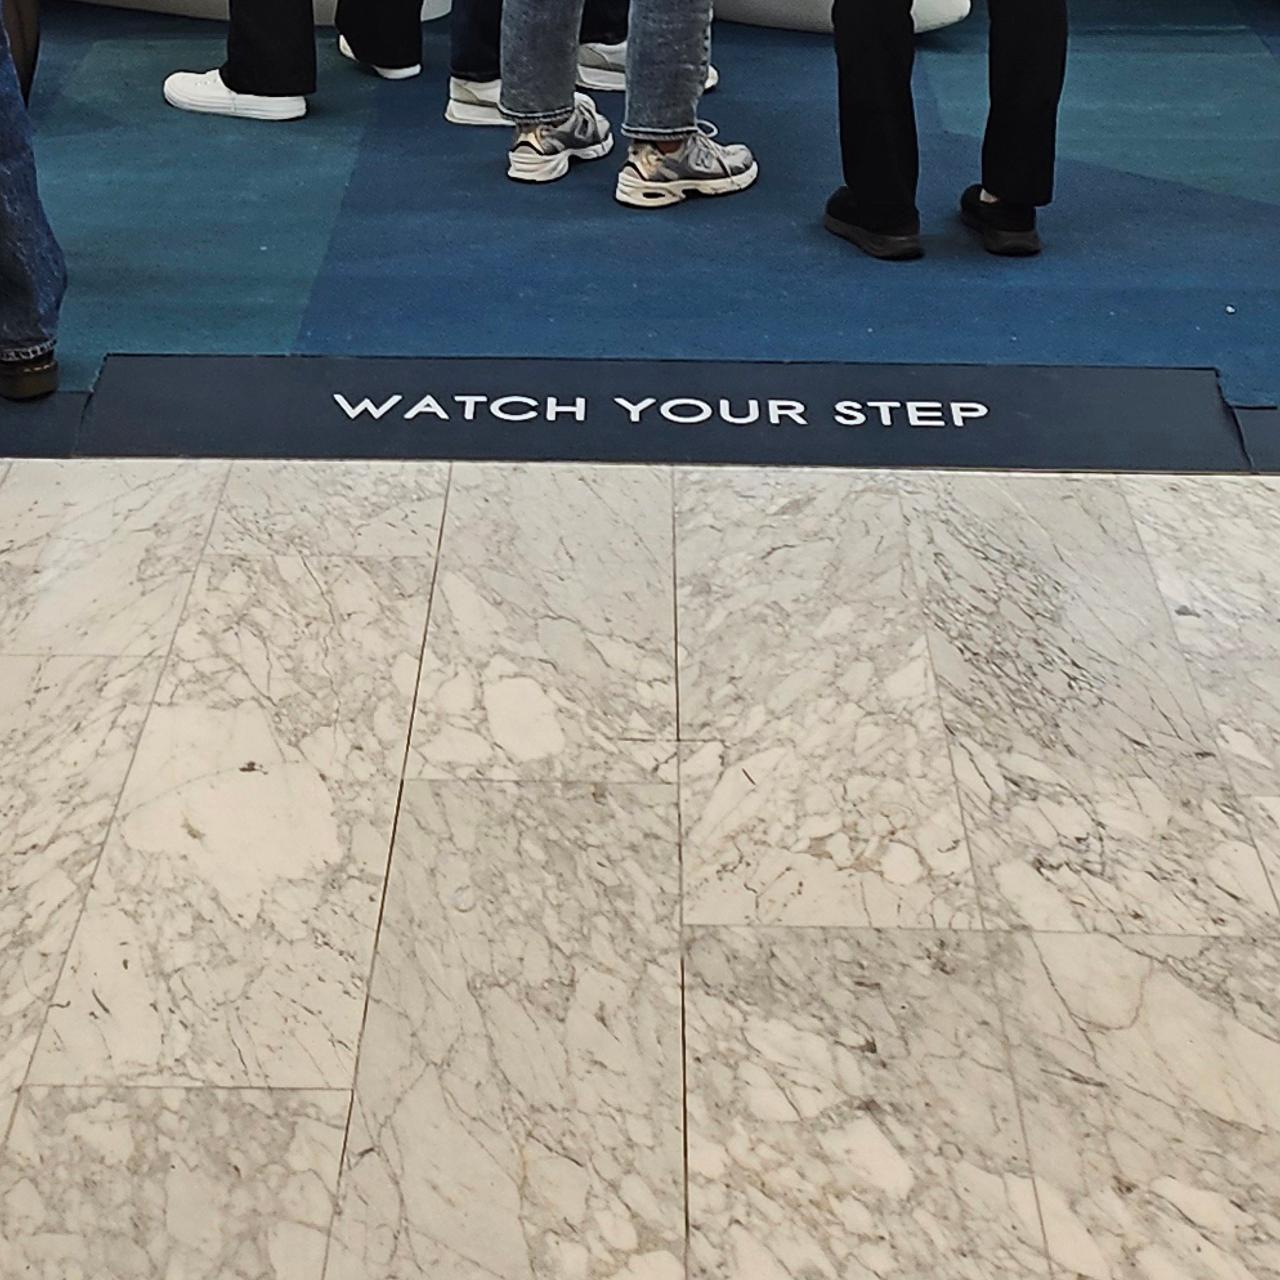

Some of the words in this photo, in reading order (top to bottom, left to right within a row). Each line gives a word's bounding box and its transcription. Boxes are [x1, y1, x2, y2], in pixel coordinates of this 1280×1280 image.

[333, 393, 586, 422] WATCH
[614, 397, 808, 425] YOUR
[834, 400, 988, 427] STEP
